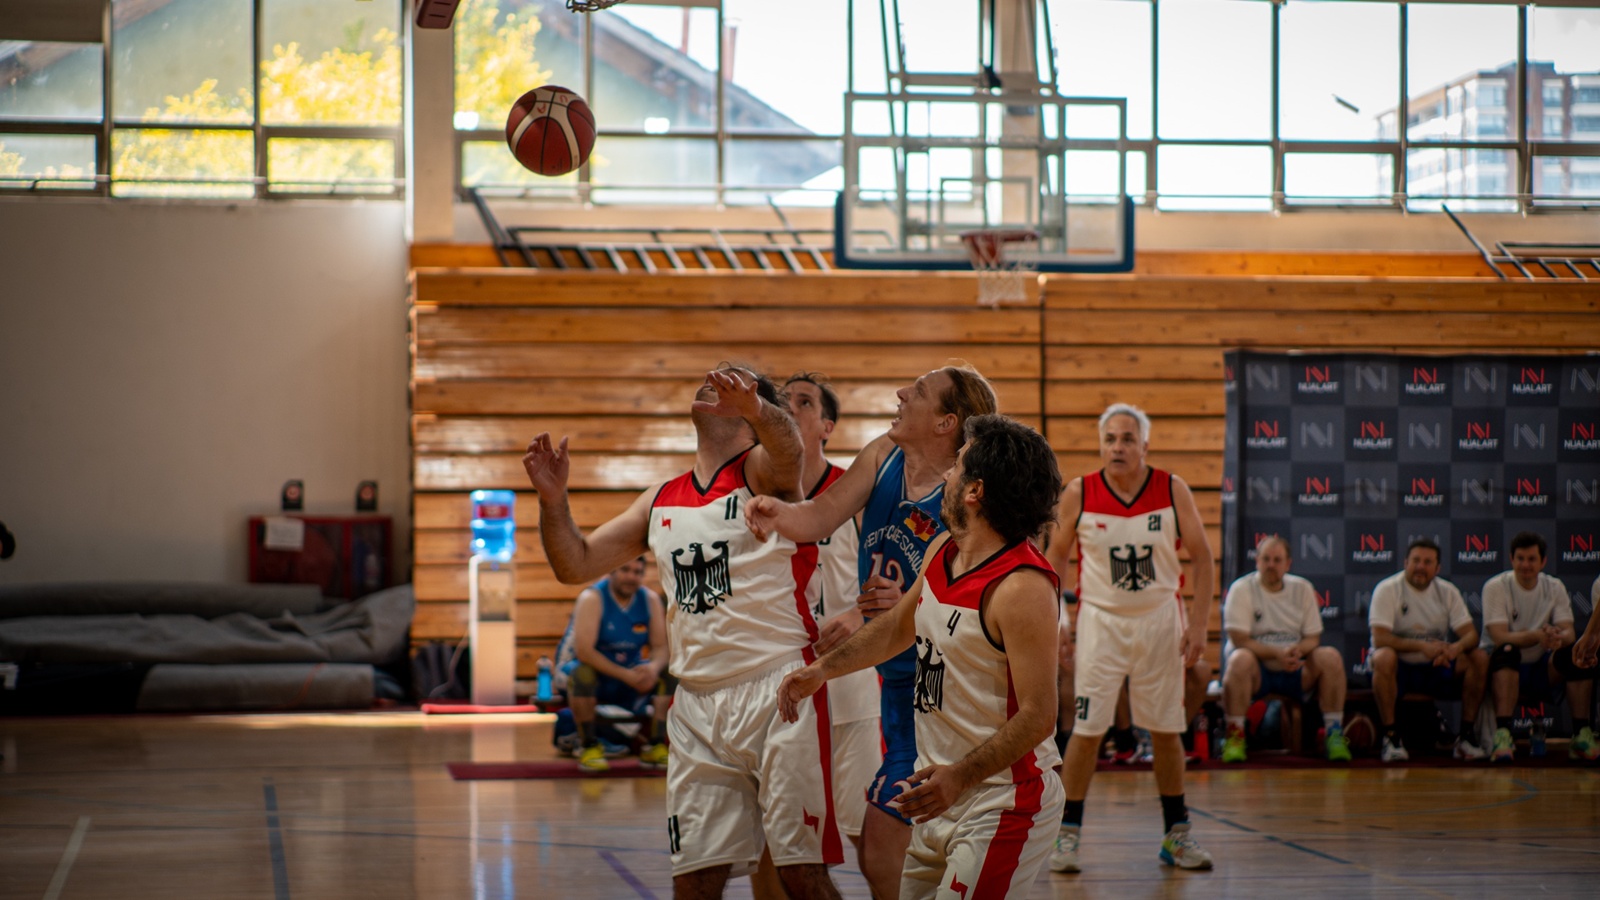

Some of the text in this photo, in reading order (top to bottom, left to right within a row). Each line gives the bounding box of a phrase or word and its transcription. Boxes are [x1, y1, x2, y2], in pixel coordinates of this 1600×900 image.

[1298, 381, 1338, 393] NUALART
[1405, 383, 1446, 394] NUALART
[1512, 384, 1552, 394] NUALART
[1247, 437, 1287, 449] NUALART
[1353, 438, 1393, 449] NUALART
[1459, 439, 1498, 450] NUALART
[1298, 493, 1338, 505] NUALART
[1404, 494, 1443, 505] NUALART
[1509, 495, 1548, 505] NUALART
[725, 495, 738, 520] 11
[1148, 514, 1162, 531] 21
[1352, 550, 1393, 562] NUALART
[1458, 551, 1498, 562] NUALART
[869, 552, 906, 592] 12
[947, 609, 961, 637] 4
[1075, 697, 1090, 720] 21
[667, 815, 681, 854] 11
